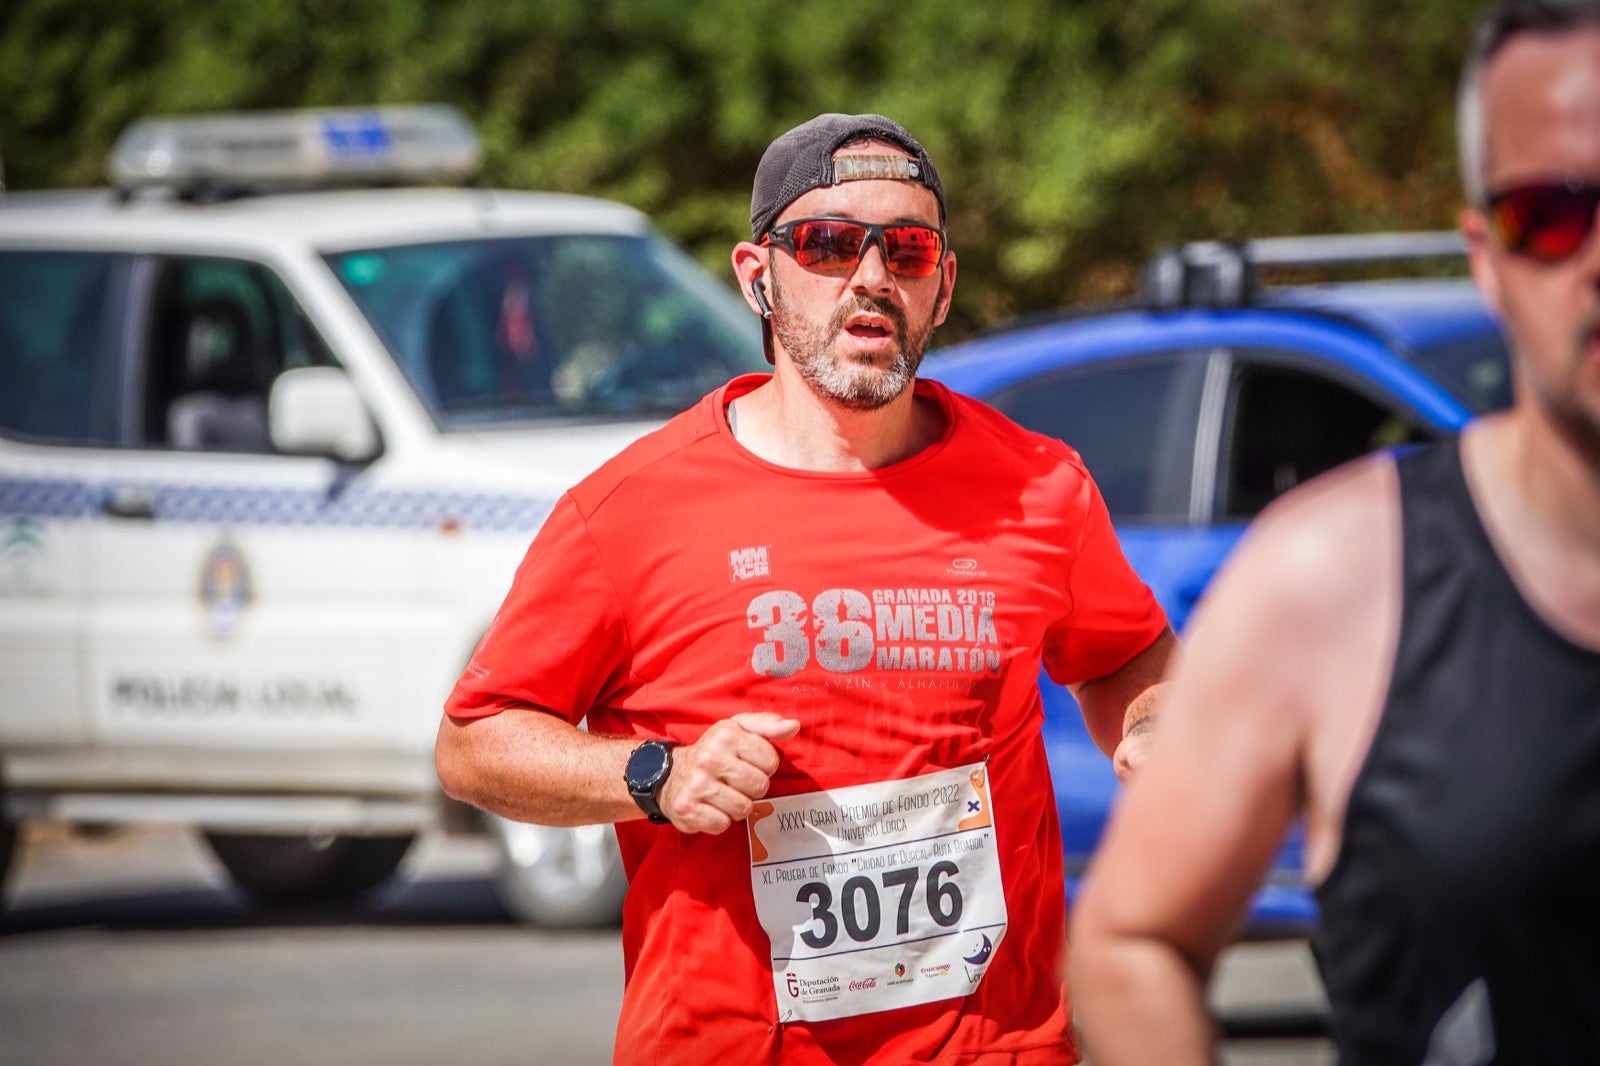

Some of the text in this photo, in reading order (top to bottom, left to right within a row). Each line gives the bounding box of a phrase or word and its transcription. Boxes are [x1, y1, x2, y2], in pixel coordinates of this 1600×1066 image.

[872, 588, 952, 604] GRANADA
[875, 604, 998, 645] MEDIA
[876, 643, 1000, 674] MARATÓN
[777, 810, 806, 832] XXXV
[809, 808, 837, 827] GRAN
[841, 803, 879, 822] PREMIO
[898, 793, 929, 813] FONDO
[933, 784, 960, 806] 2022
[880, 818, 908, 835] LORCA
[762, 869, 773, 885] XL
[796, 860, 963, 949] 3076
[800, 975, 839, 988] Diputación
[801, 983, 840, 996] de Granada
